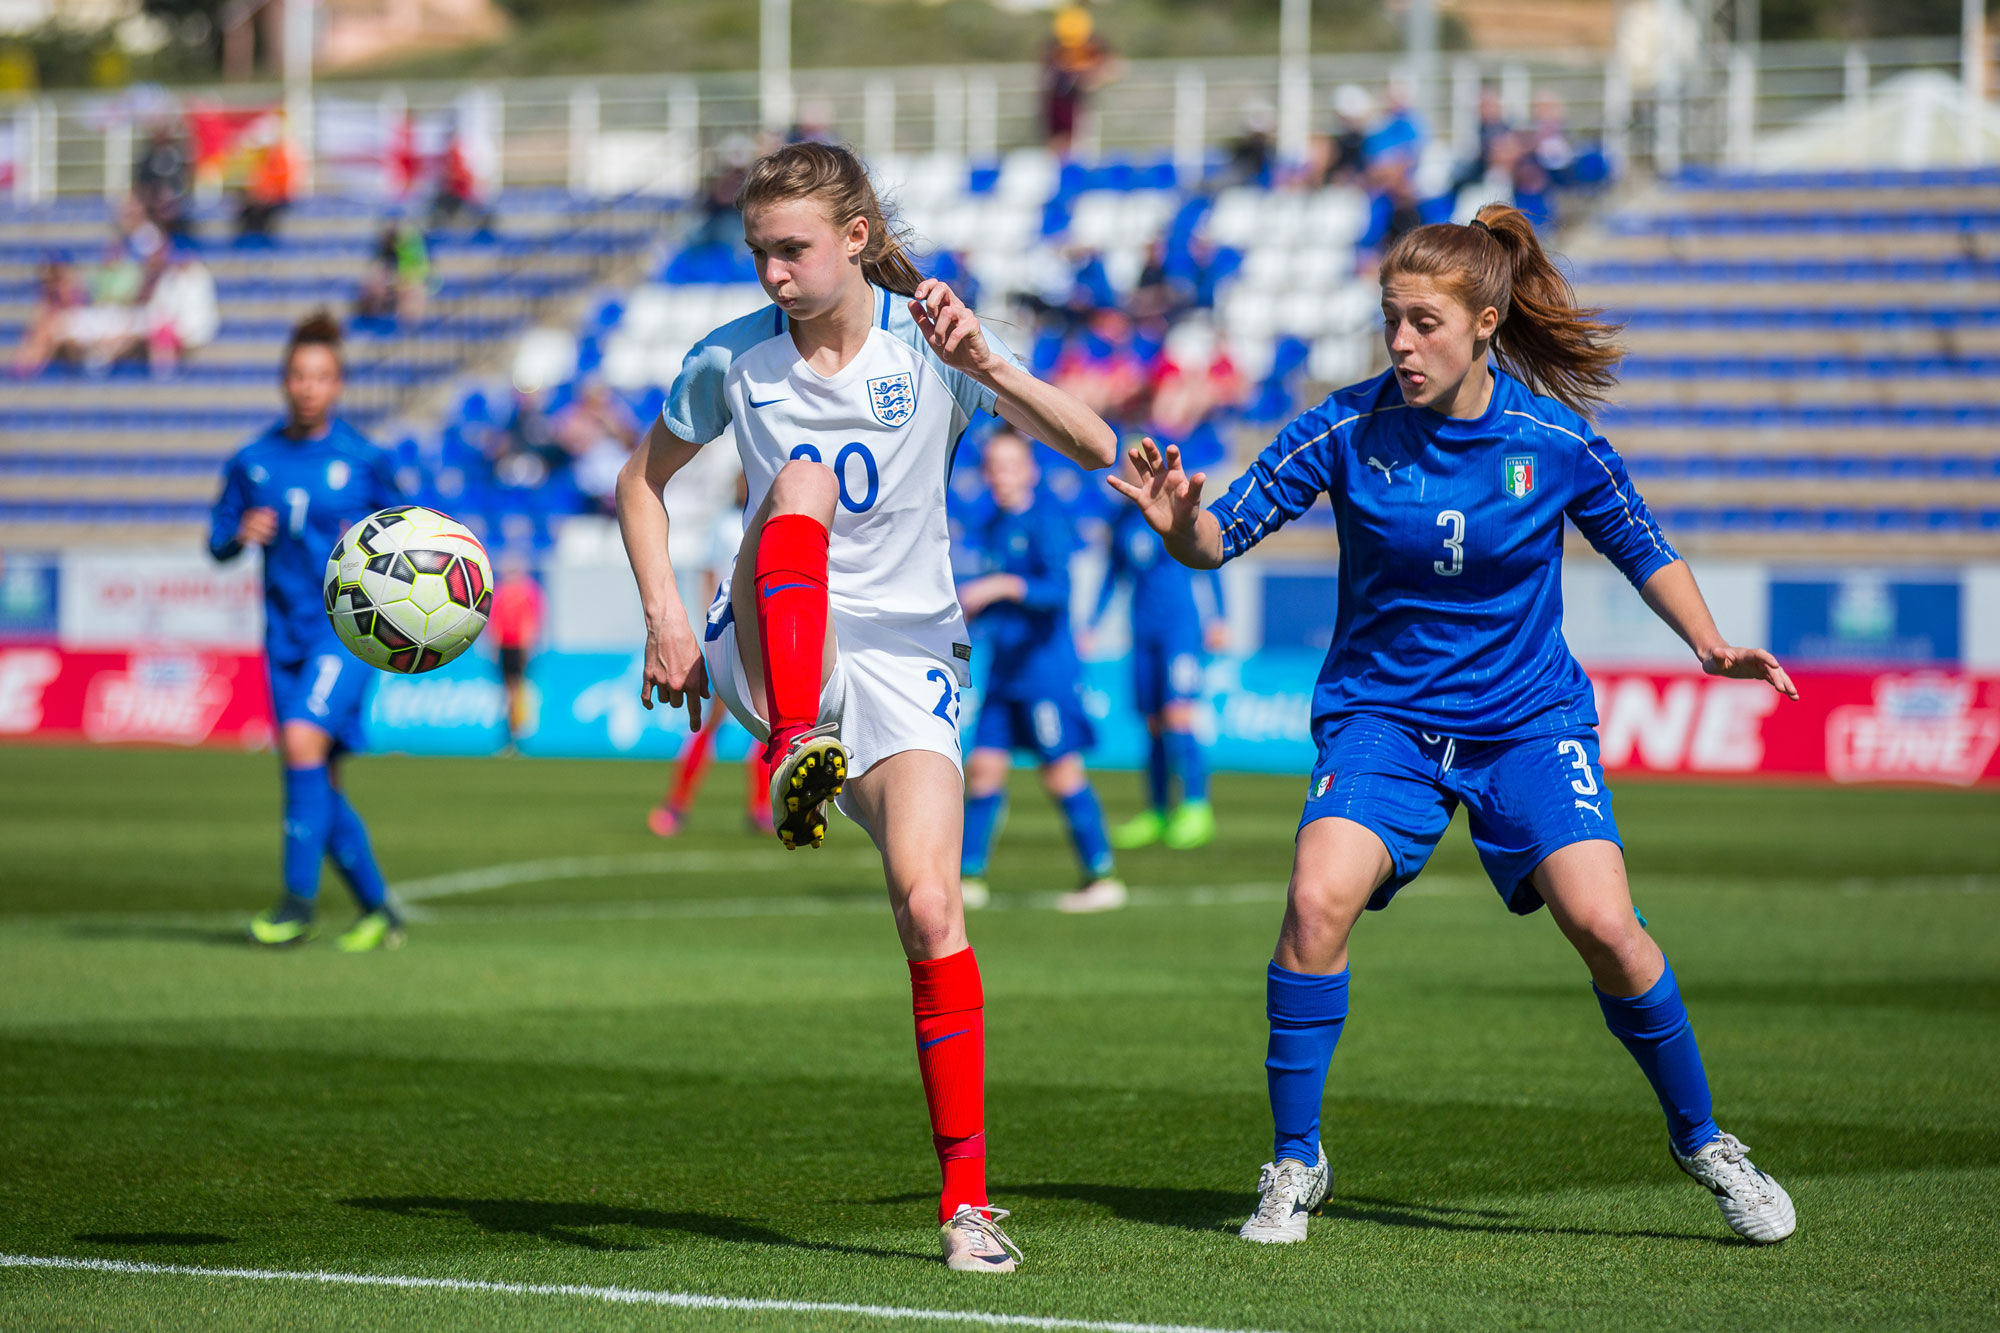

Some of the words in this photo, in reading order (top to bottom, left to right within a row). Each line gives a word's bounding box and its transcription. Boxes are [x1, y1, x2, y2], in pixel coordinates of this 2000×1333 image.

[789, 442, 879, 513] 0
[1434, 510, 1465, 576] 3
[927, 670, 961, 752] 2
[1558, 740, 1598, 795] 3
